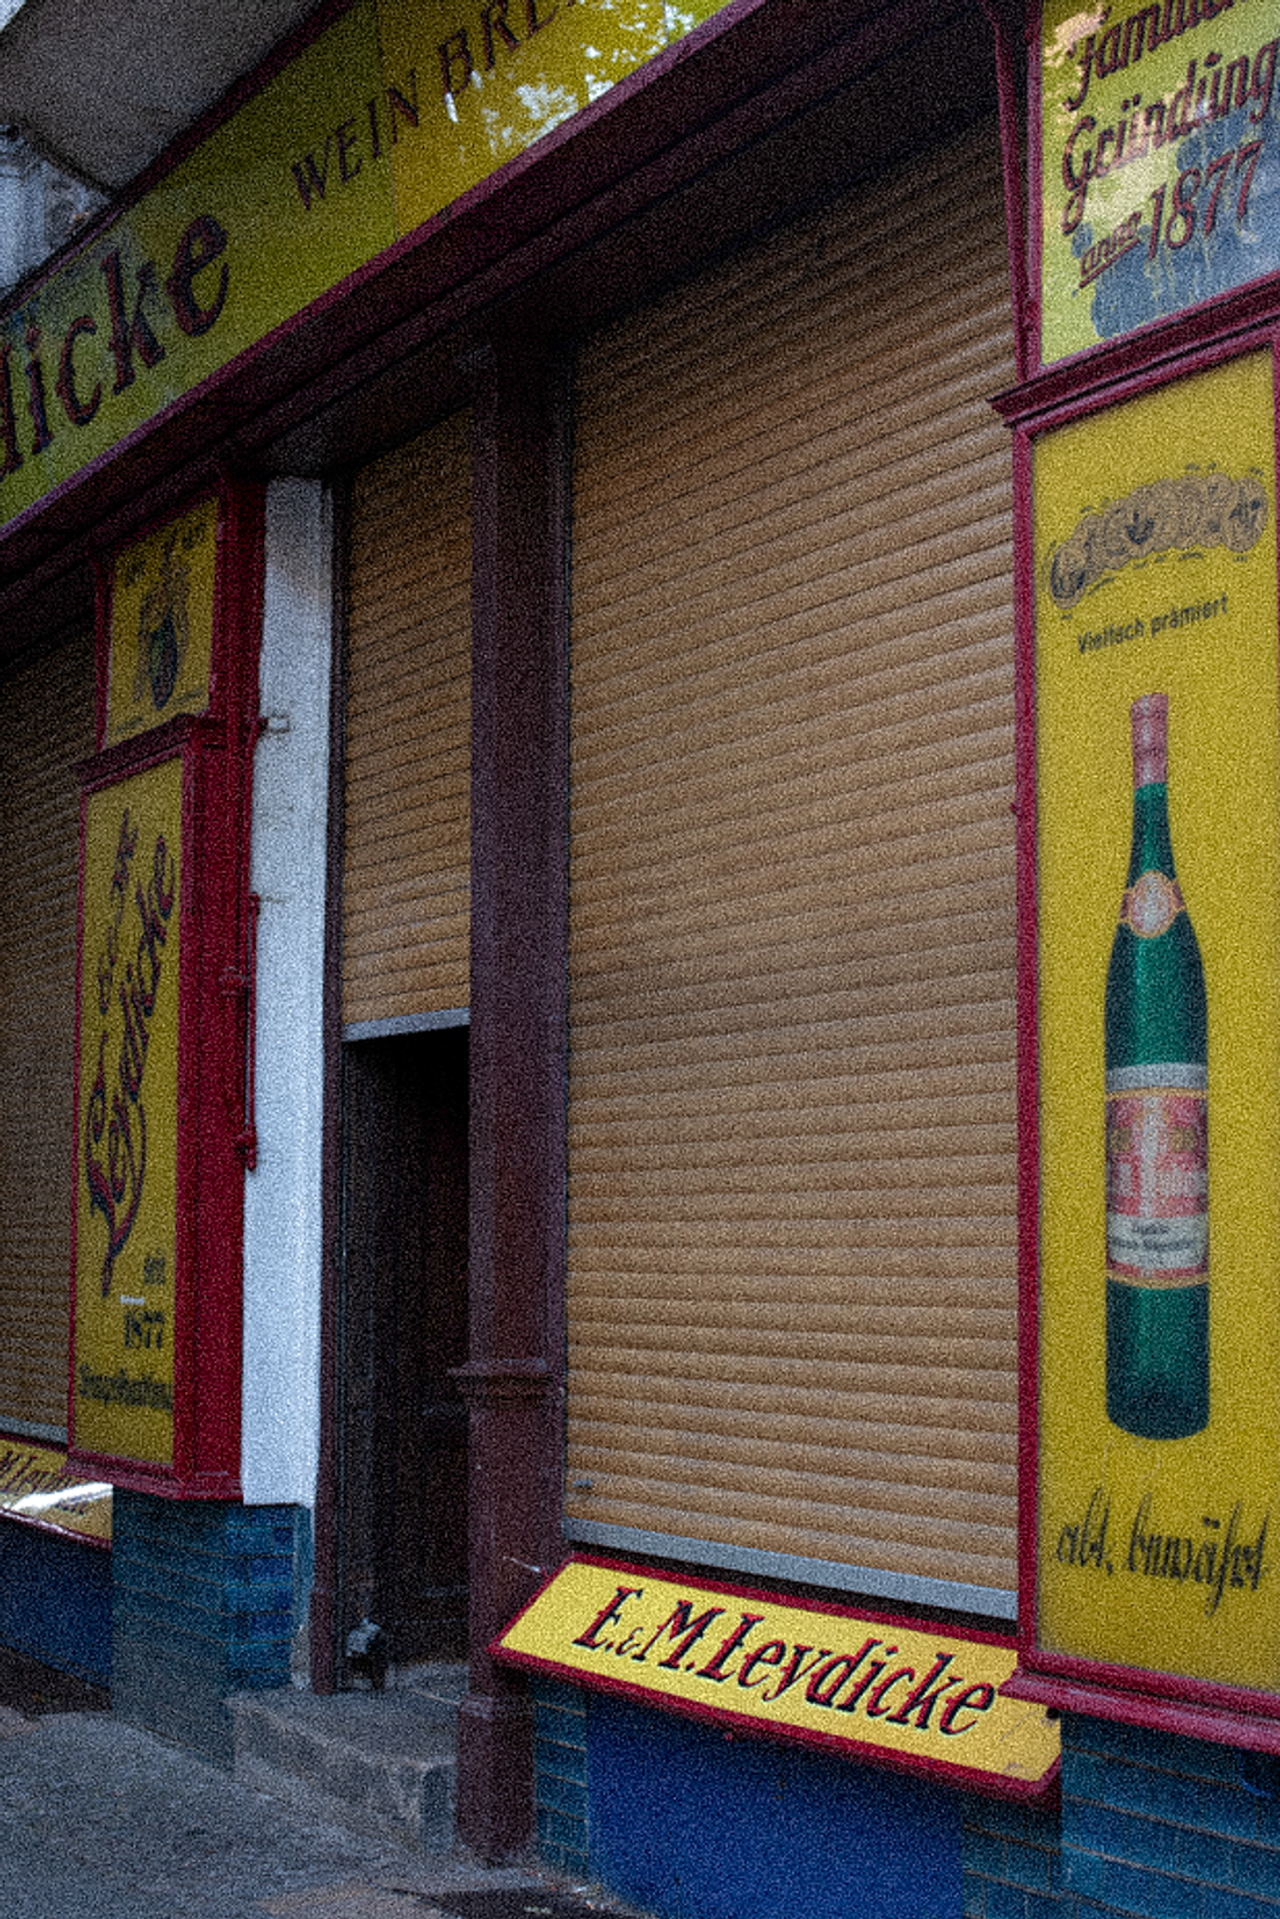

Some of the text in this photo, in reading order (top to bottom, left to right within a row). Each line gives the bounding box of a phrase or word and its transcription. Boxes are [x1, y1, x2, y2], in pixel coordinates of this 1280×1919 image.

[1149, 138, 1266, 260] 1877
[1077, 591, 1228, 654] Vielfach prämiert
